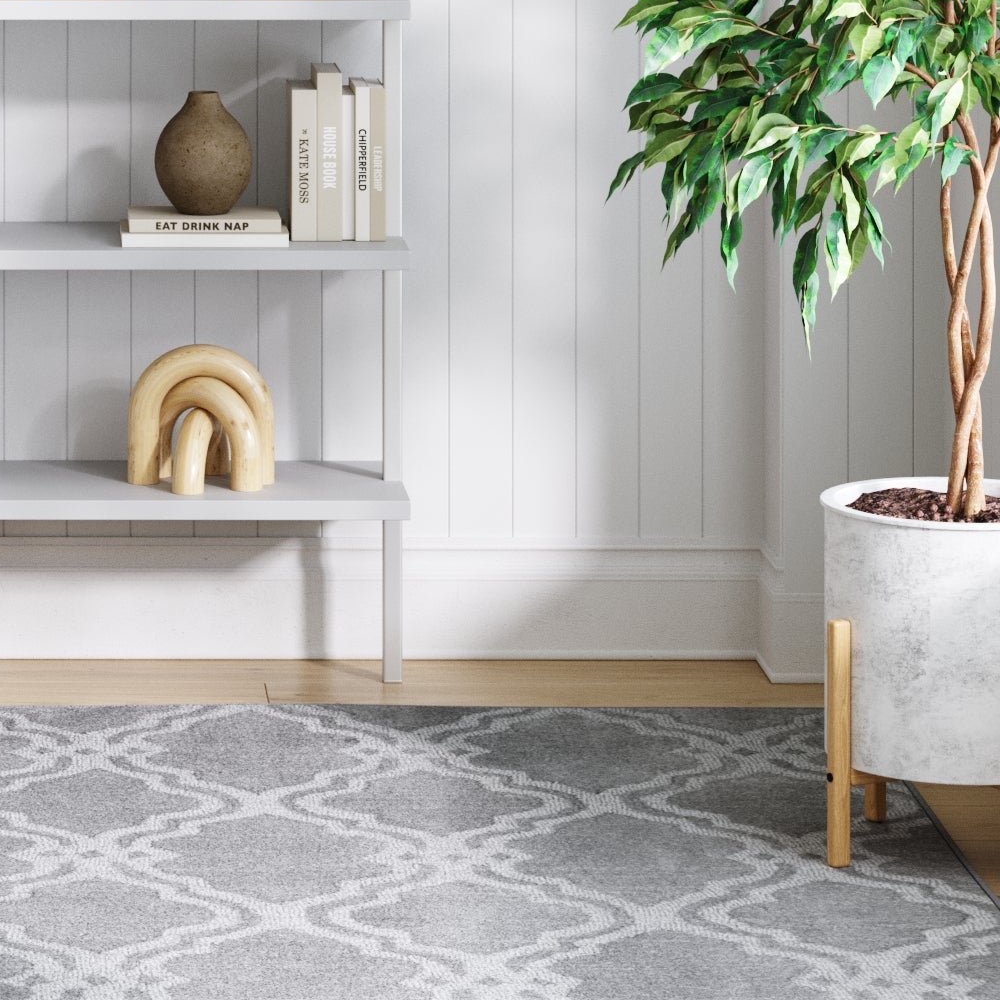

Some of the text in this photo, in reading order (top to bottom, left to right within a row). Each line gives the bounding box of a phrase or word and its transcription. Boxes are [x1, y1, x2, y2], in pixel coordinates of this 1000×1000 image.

[298, 139, 309, 169] KATE
[323, 126, 336, 189] HOUSE BOOK
[358, 128, 367, 191] CHIPPERFIELD
[298, 170, 309, 204] MOSS
[155, 222, 249, 231] EAT DRINK NAP
